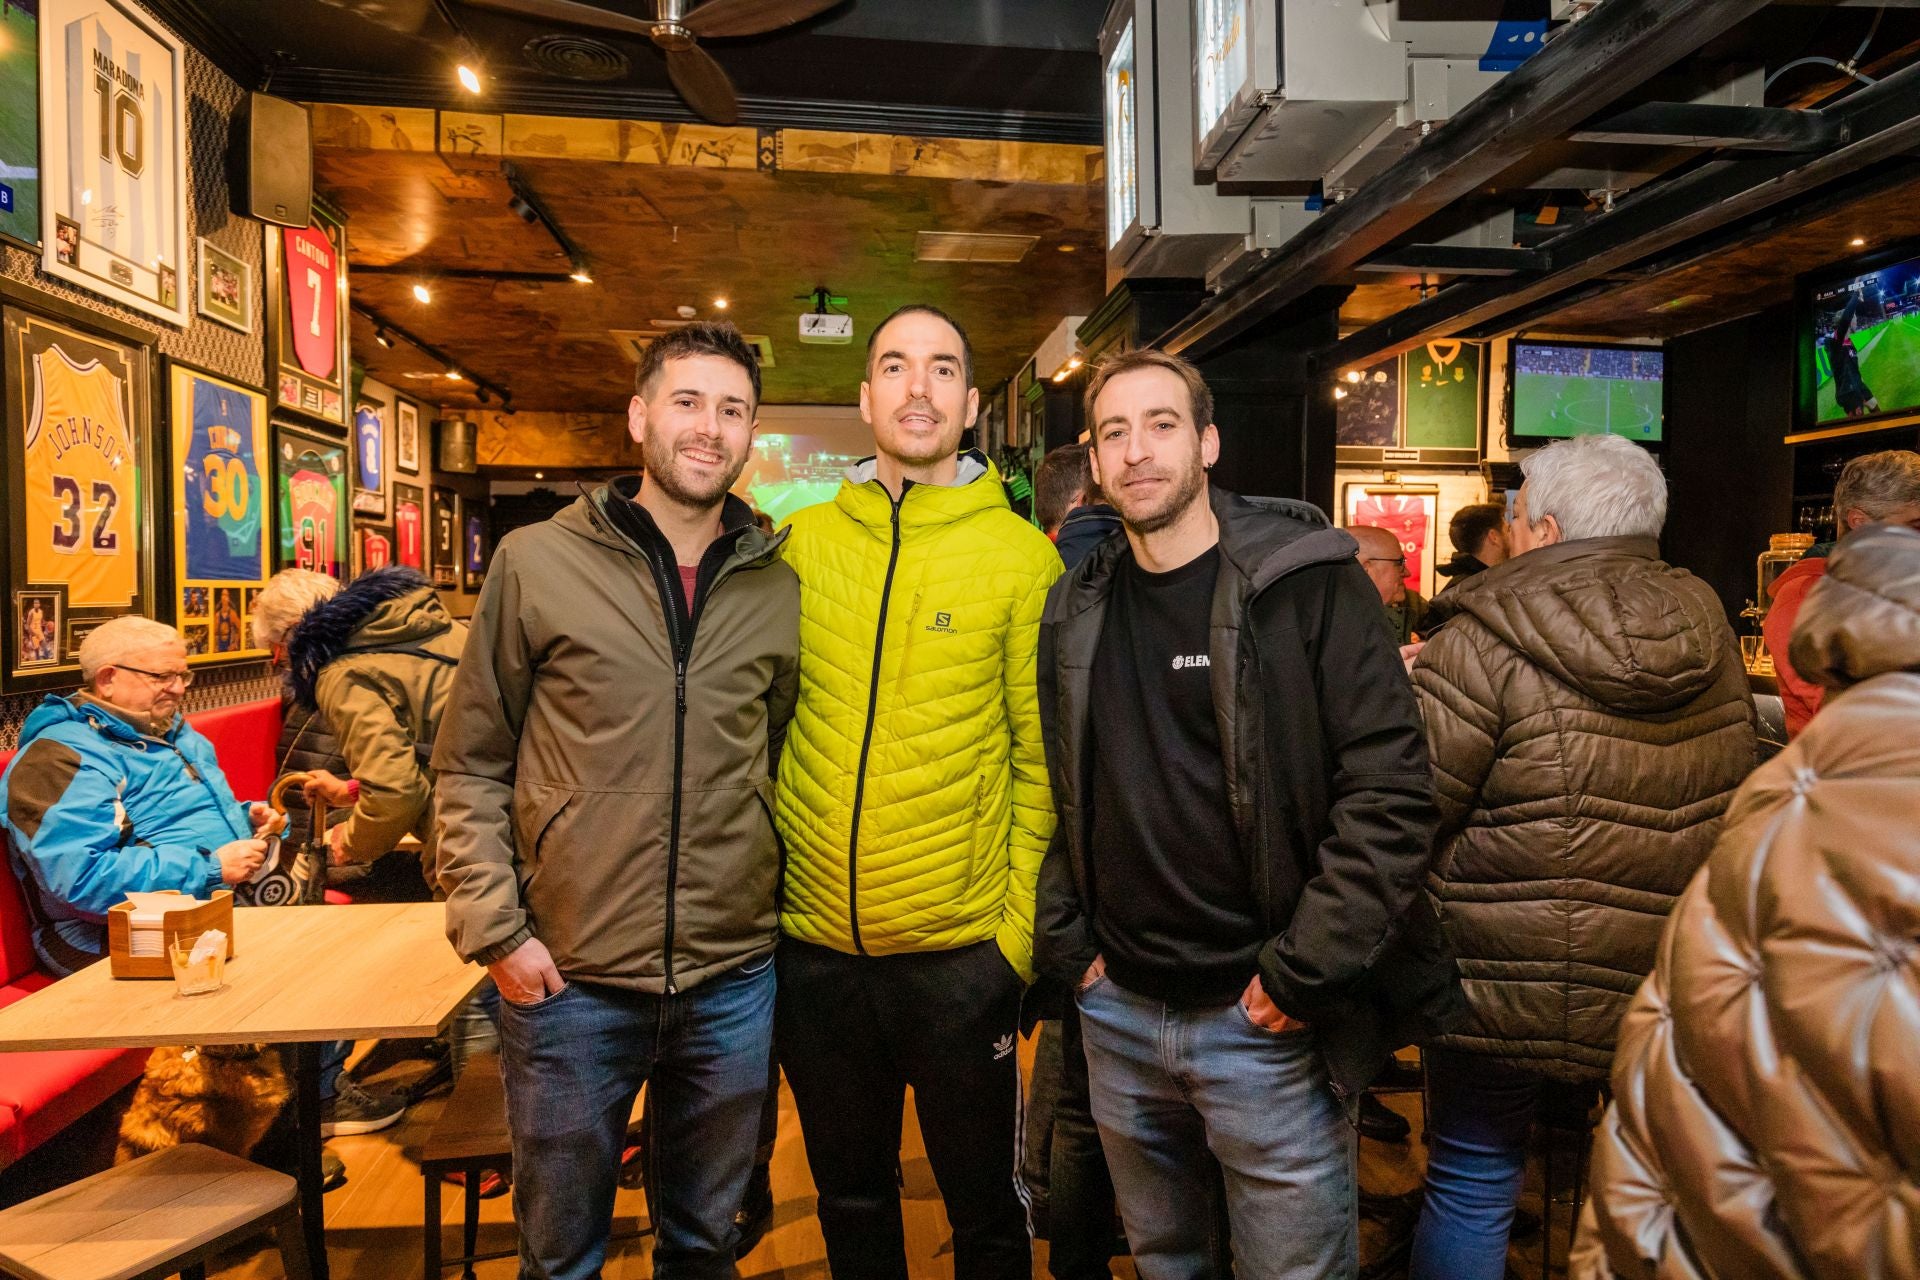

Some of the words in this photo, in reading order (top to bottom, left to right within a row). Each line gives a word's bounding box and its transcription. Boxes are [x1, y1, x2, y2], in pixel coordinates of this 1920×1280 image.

[93, 48, 145, 101] MARADONA
[94, 69, 145, 180] 10
[306, 267, 321, 337] 7
[48, 416, 125, 472] JOHNSON
[51, 474, 120, 556] 32
[202, 453, 249, 521] 30
[300, 516, 329, 574] 91
[441, 520, 450, 550] 3
[473, 535, 481, 563] 2
